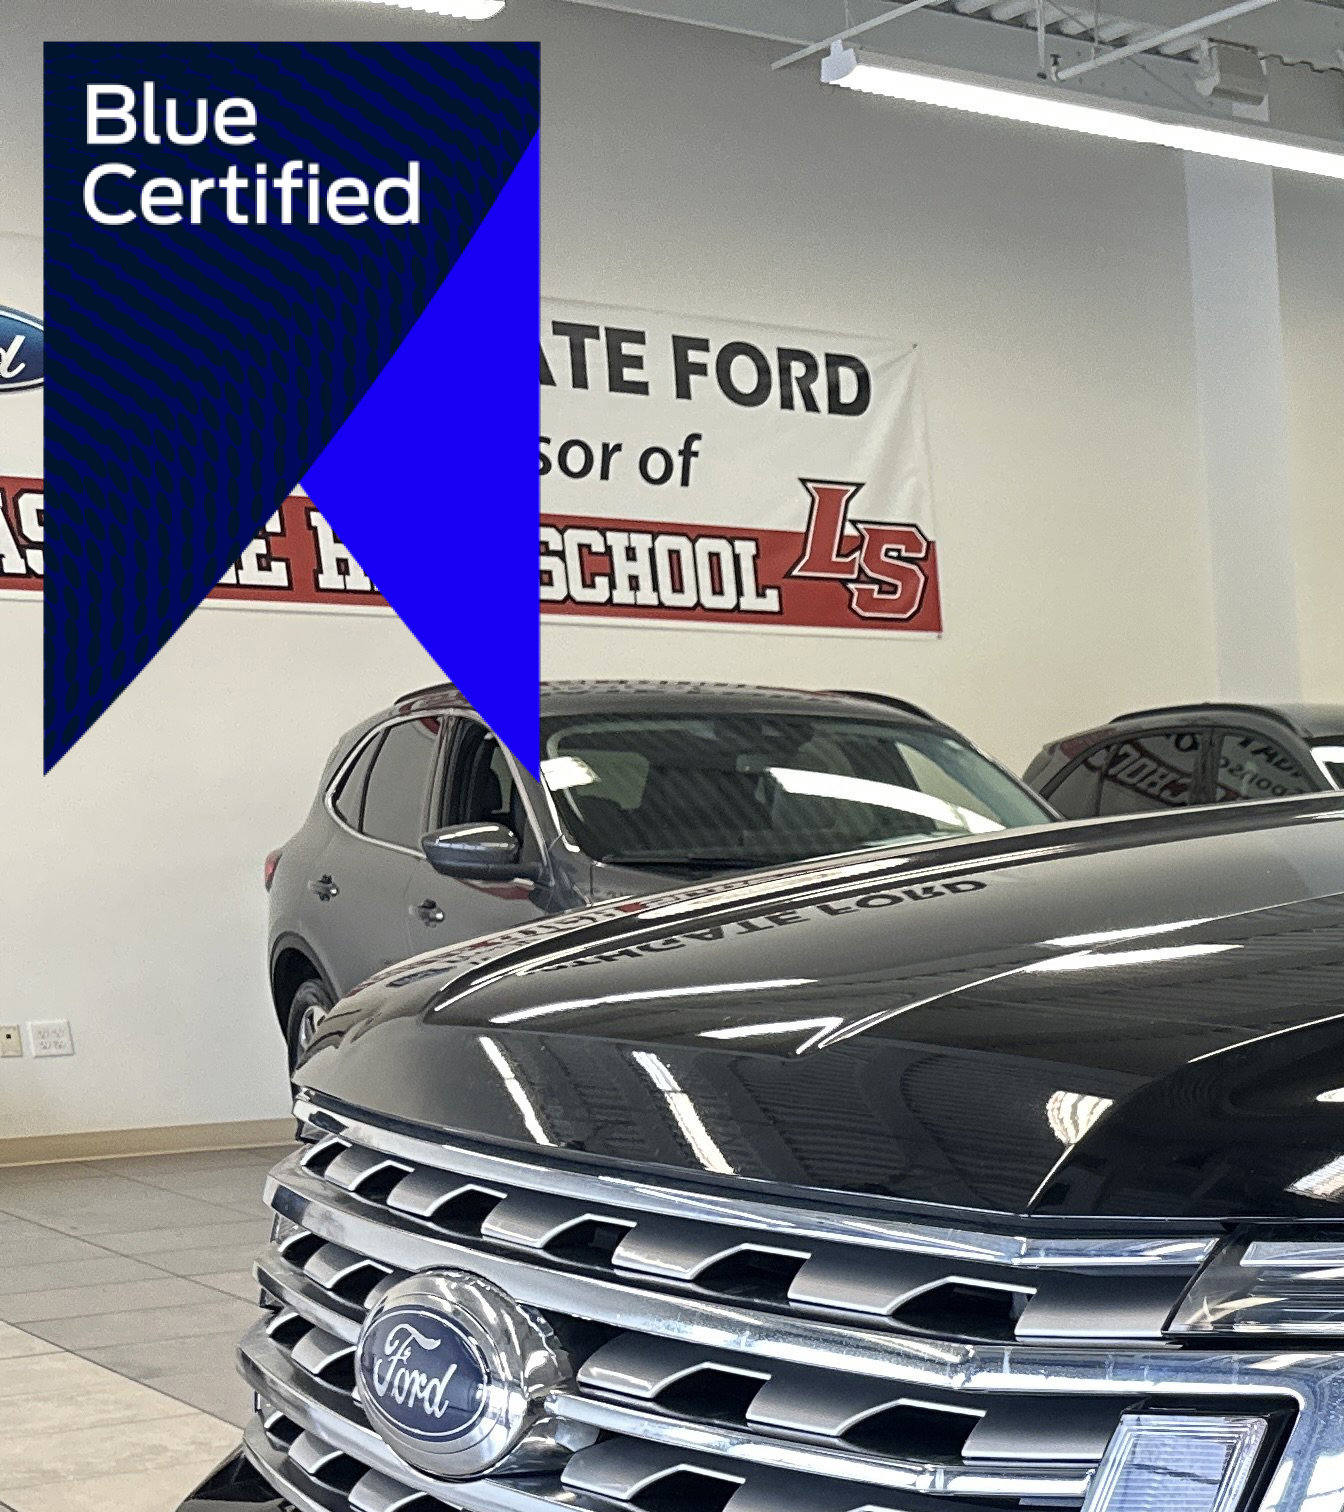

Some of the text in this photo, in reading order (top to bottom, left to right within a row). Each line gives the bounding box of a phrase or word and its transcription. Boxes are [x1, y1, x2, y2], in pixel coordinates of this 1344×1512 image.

[671, 333, 872, 417] FORD
[638, 432, 703, 488] of
[540, 523, 784, 615] SCHOOL
[784, 477, 930, 622] LS
[373, 1323, 457, 1418] Ford
